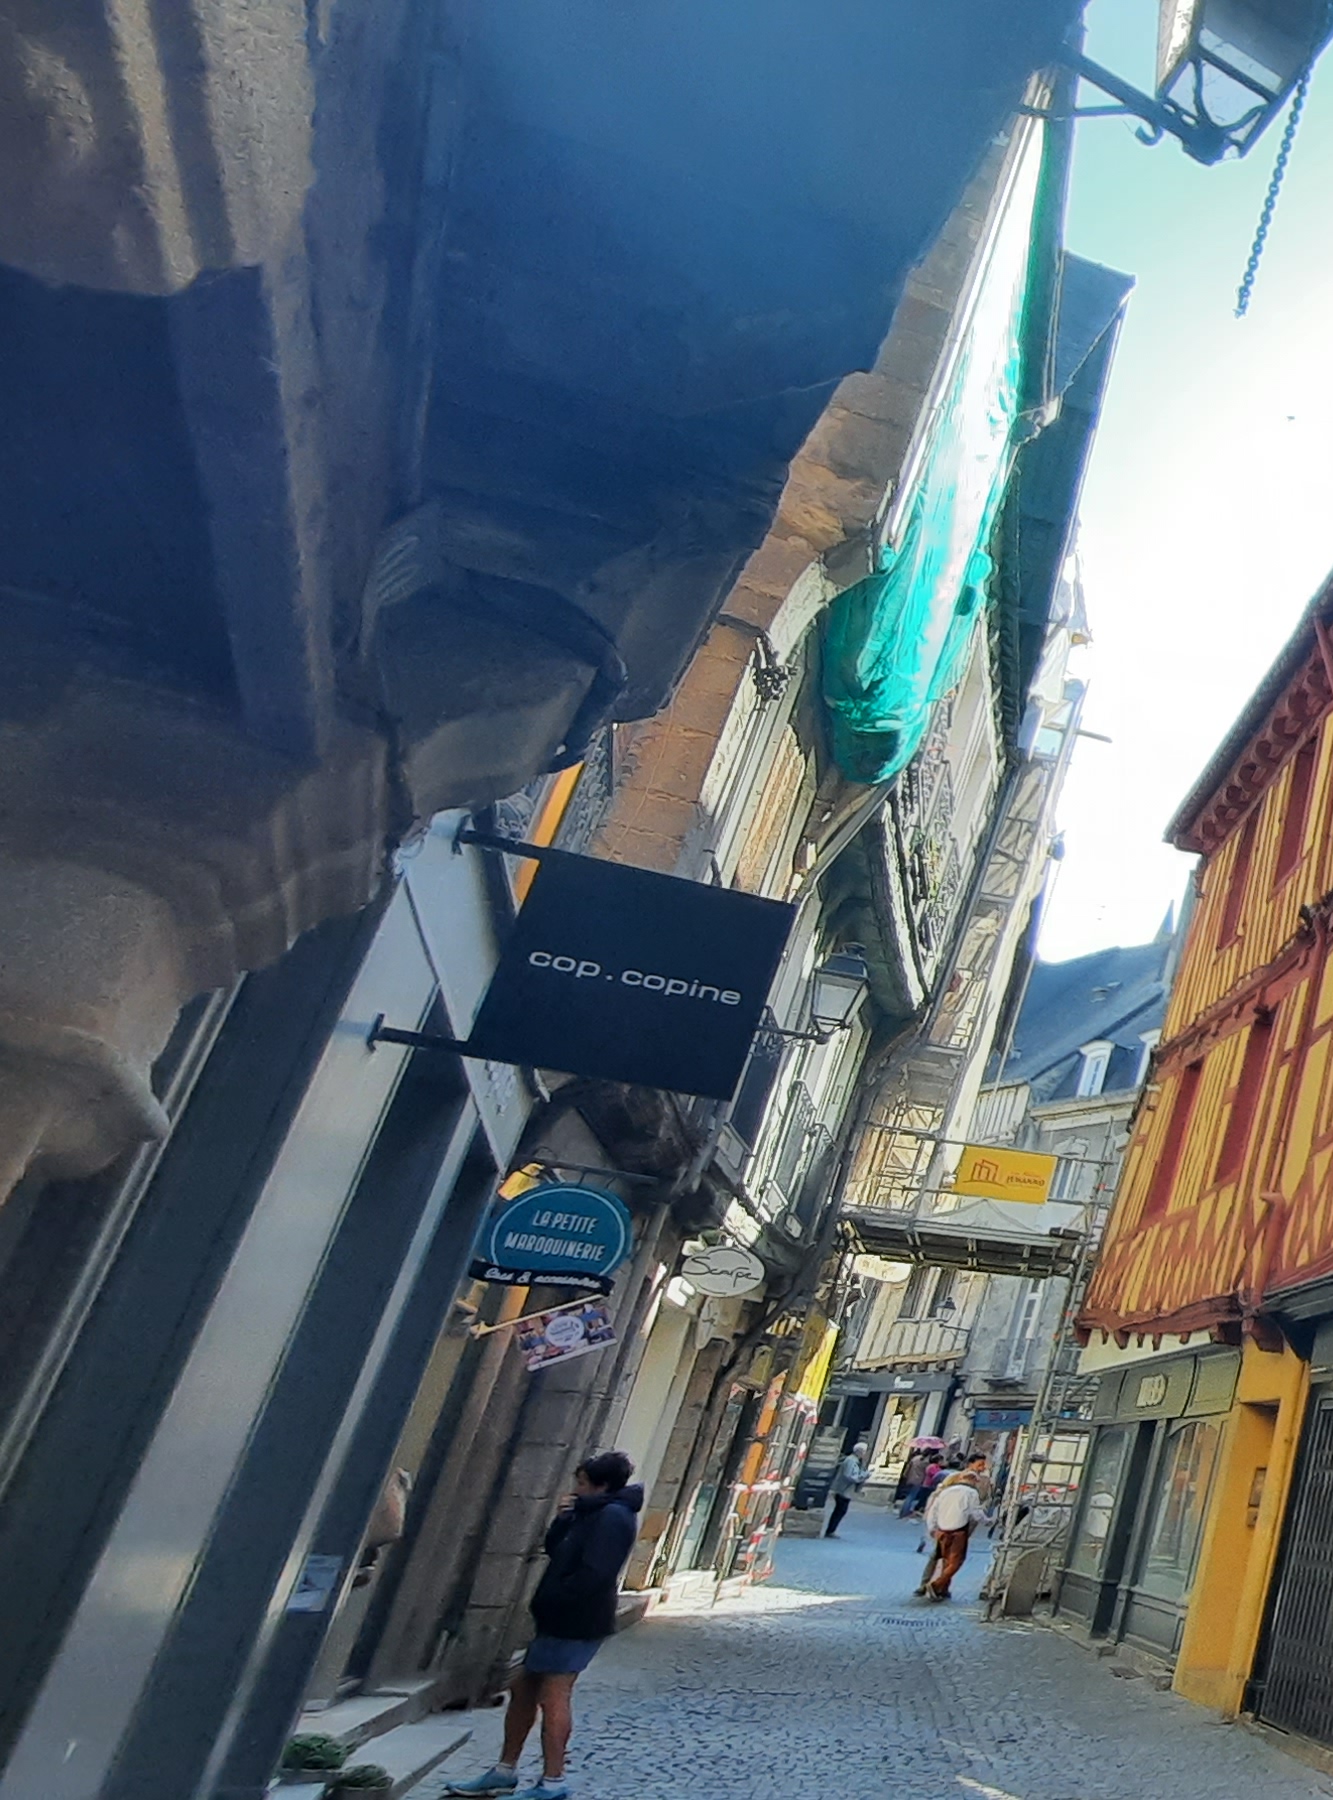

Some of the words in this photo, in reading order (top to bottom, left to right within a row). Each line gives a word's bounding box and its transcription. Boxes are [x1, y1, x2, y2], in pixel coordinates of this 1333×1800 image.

[532, 1209, 551, 1227] LA
[550, 1212, 599, 1235] PETITE
[504, 1230, 605, 1262] MAROQUINERIE
